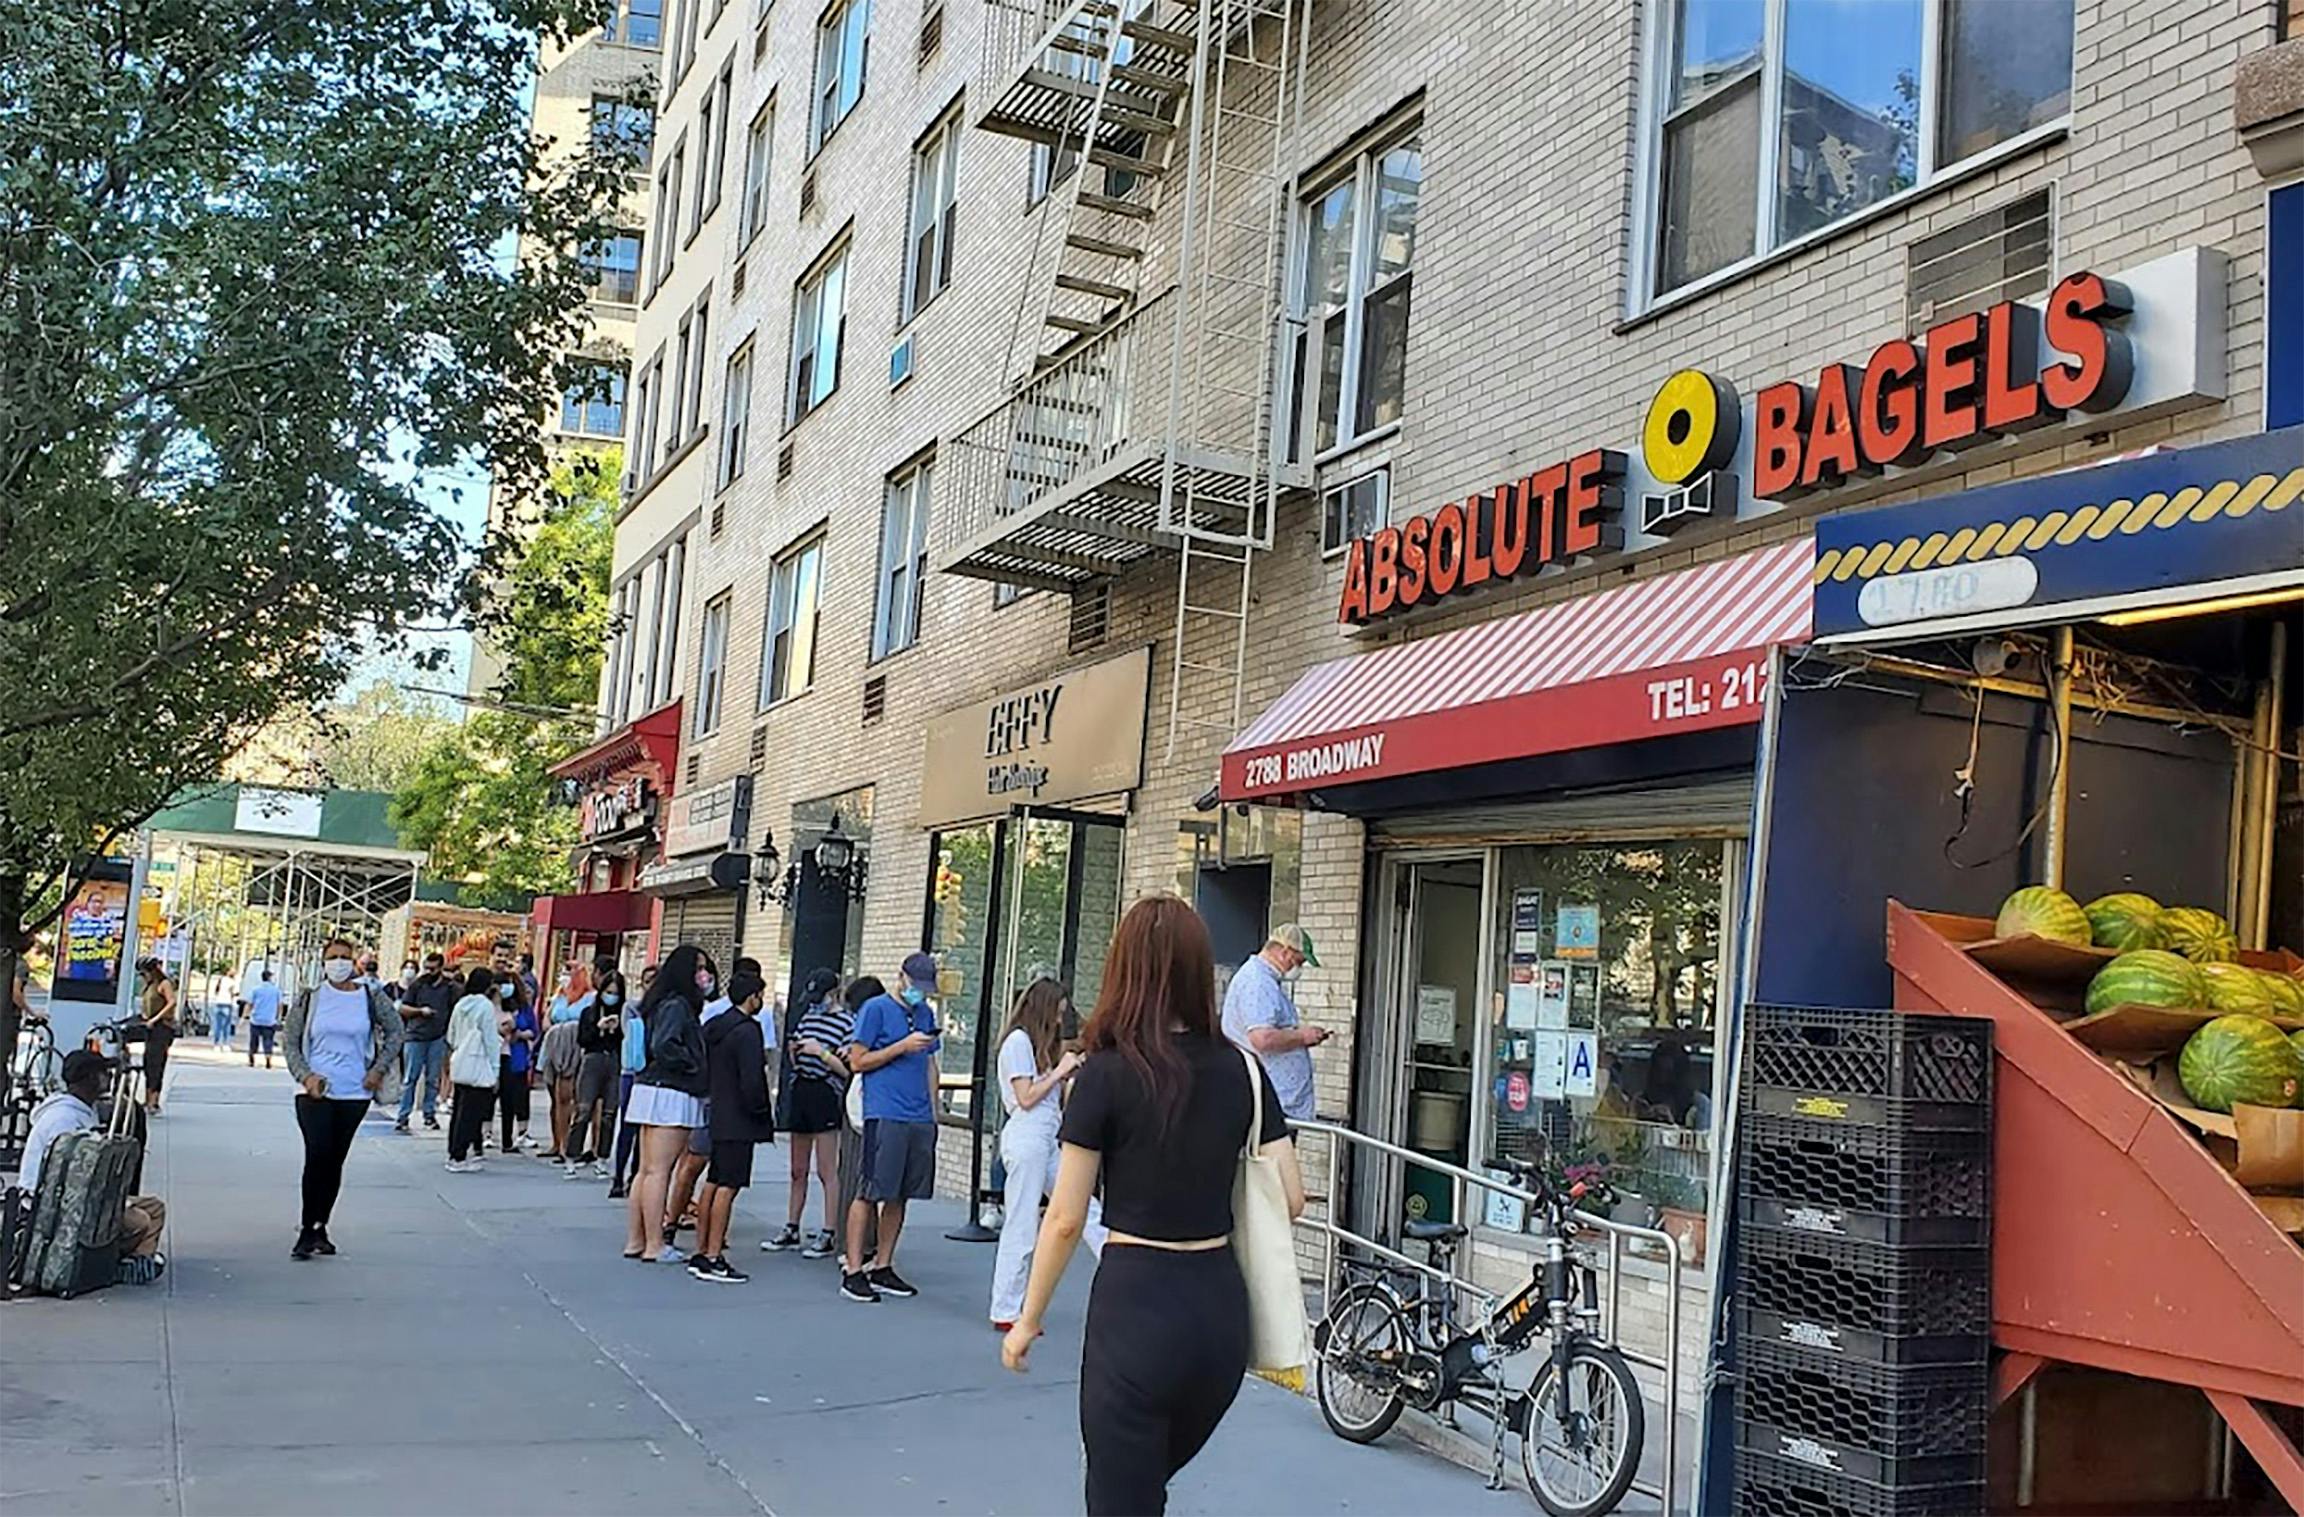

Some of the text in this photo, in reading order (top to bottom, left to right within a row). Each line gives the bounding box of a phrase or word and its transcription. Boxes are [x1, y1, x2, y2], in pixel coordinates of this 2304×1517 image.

[1338, 272, 2110, 624] ABSOLUTE BAGELS
[1245, 755, 1282, 788] 2788
[1287, 733, 1385, 781] BROADWAY
[1647, 676, 1711, 720] TEL:
[1572, 1041, 1592, 1078] A
